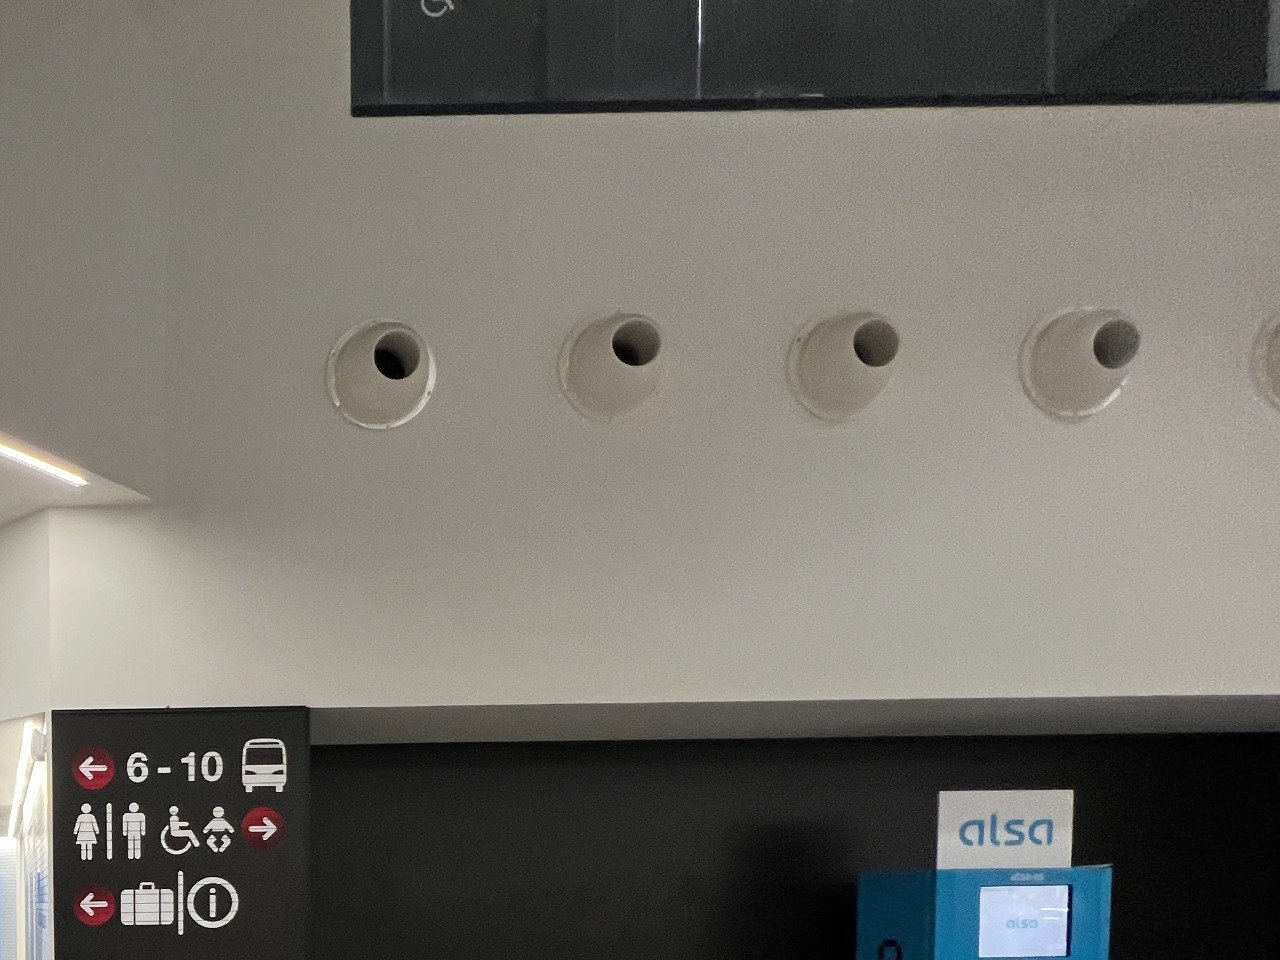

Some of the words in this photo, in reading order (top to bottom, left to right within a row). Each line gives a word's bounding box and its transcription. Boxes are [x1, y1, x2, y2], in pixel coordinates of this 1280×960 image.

[126, 751, 149, 783] 6
[180, 751, 224, 782] 10
[958, 813, 1054, 847] alsa
[1005, 917, 1039, 930] alsa
